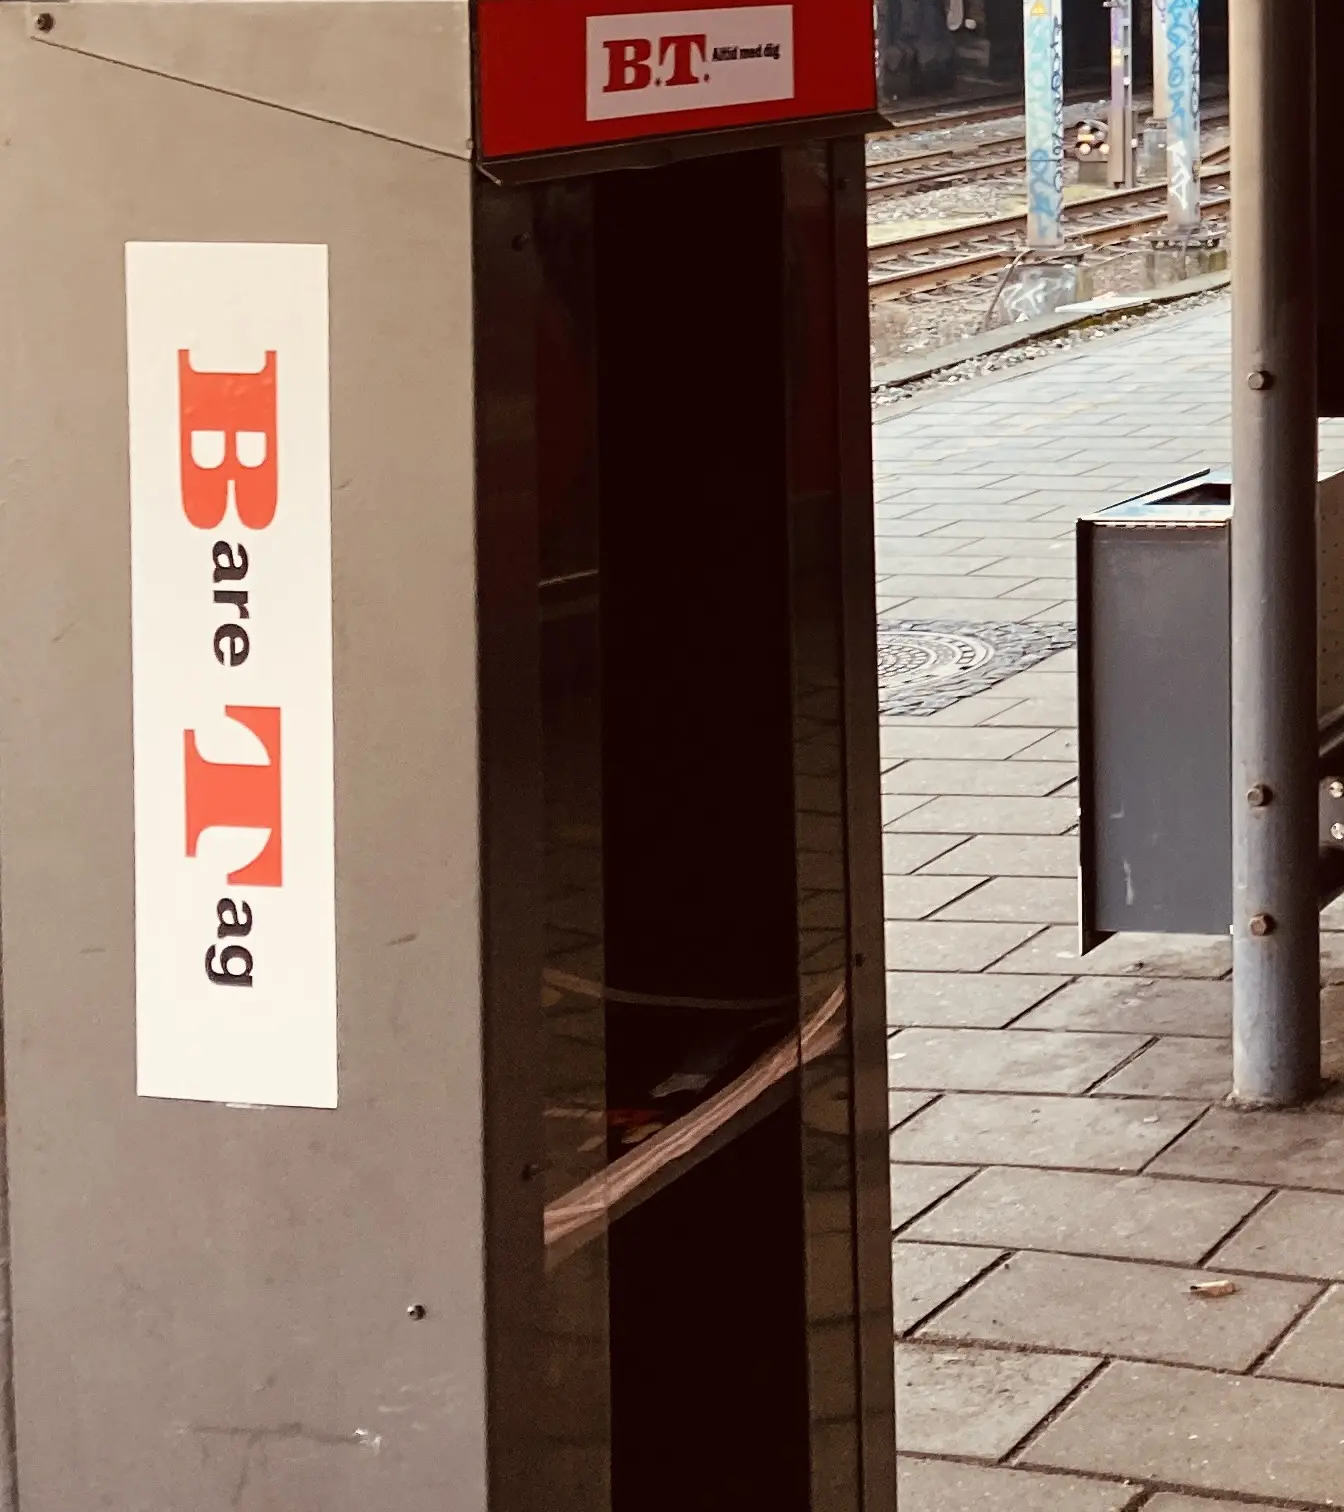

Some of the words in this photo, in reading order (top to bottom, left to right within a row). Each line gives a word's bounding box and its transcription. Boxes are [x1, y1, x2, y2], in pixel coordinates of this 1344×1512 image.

[602, 33, 710, 93] B.T.
[739, 44, 762, 60] med
[763, 42, 780, 60] dig
[177, 349, 279, 668] Bare
[183, 705, 283, 988] Tag
